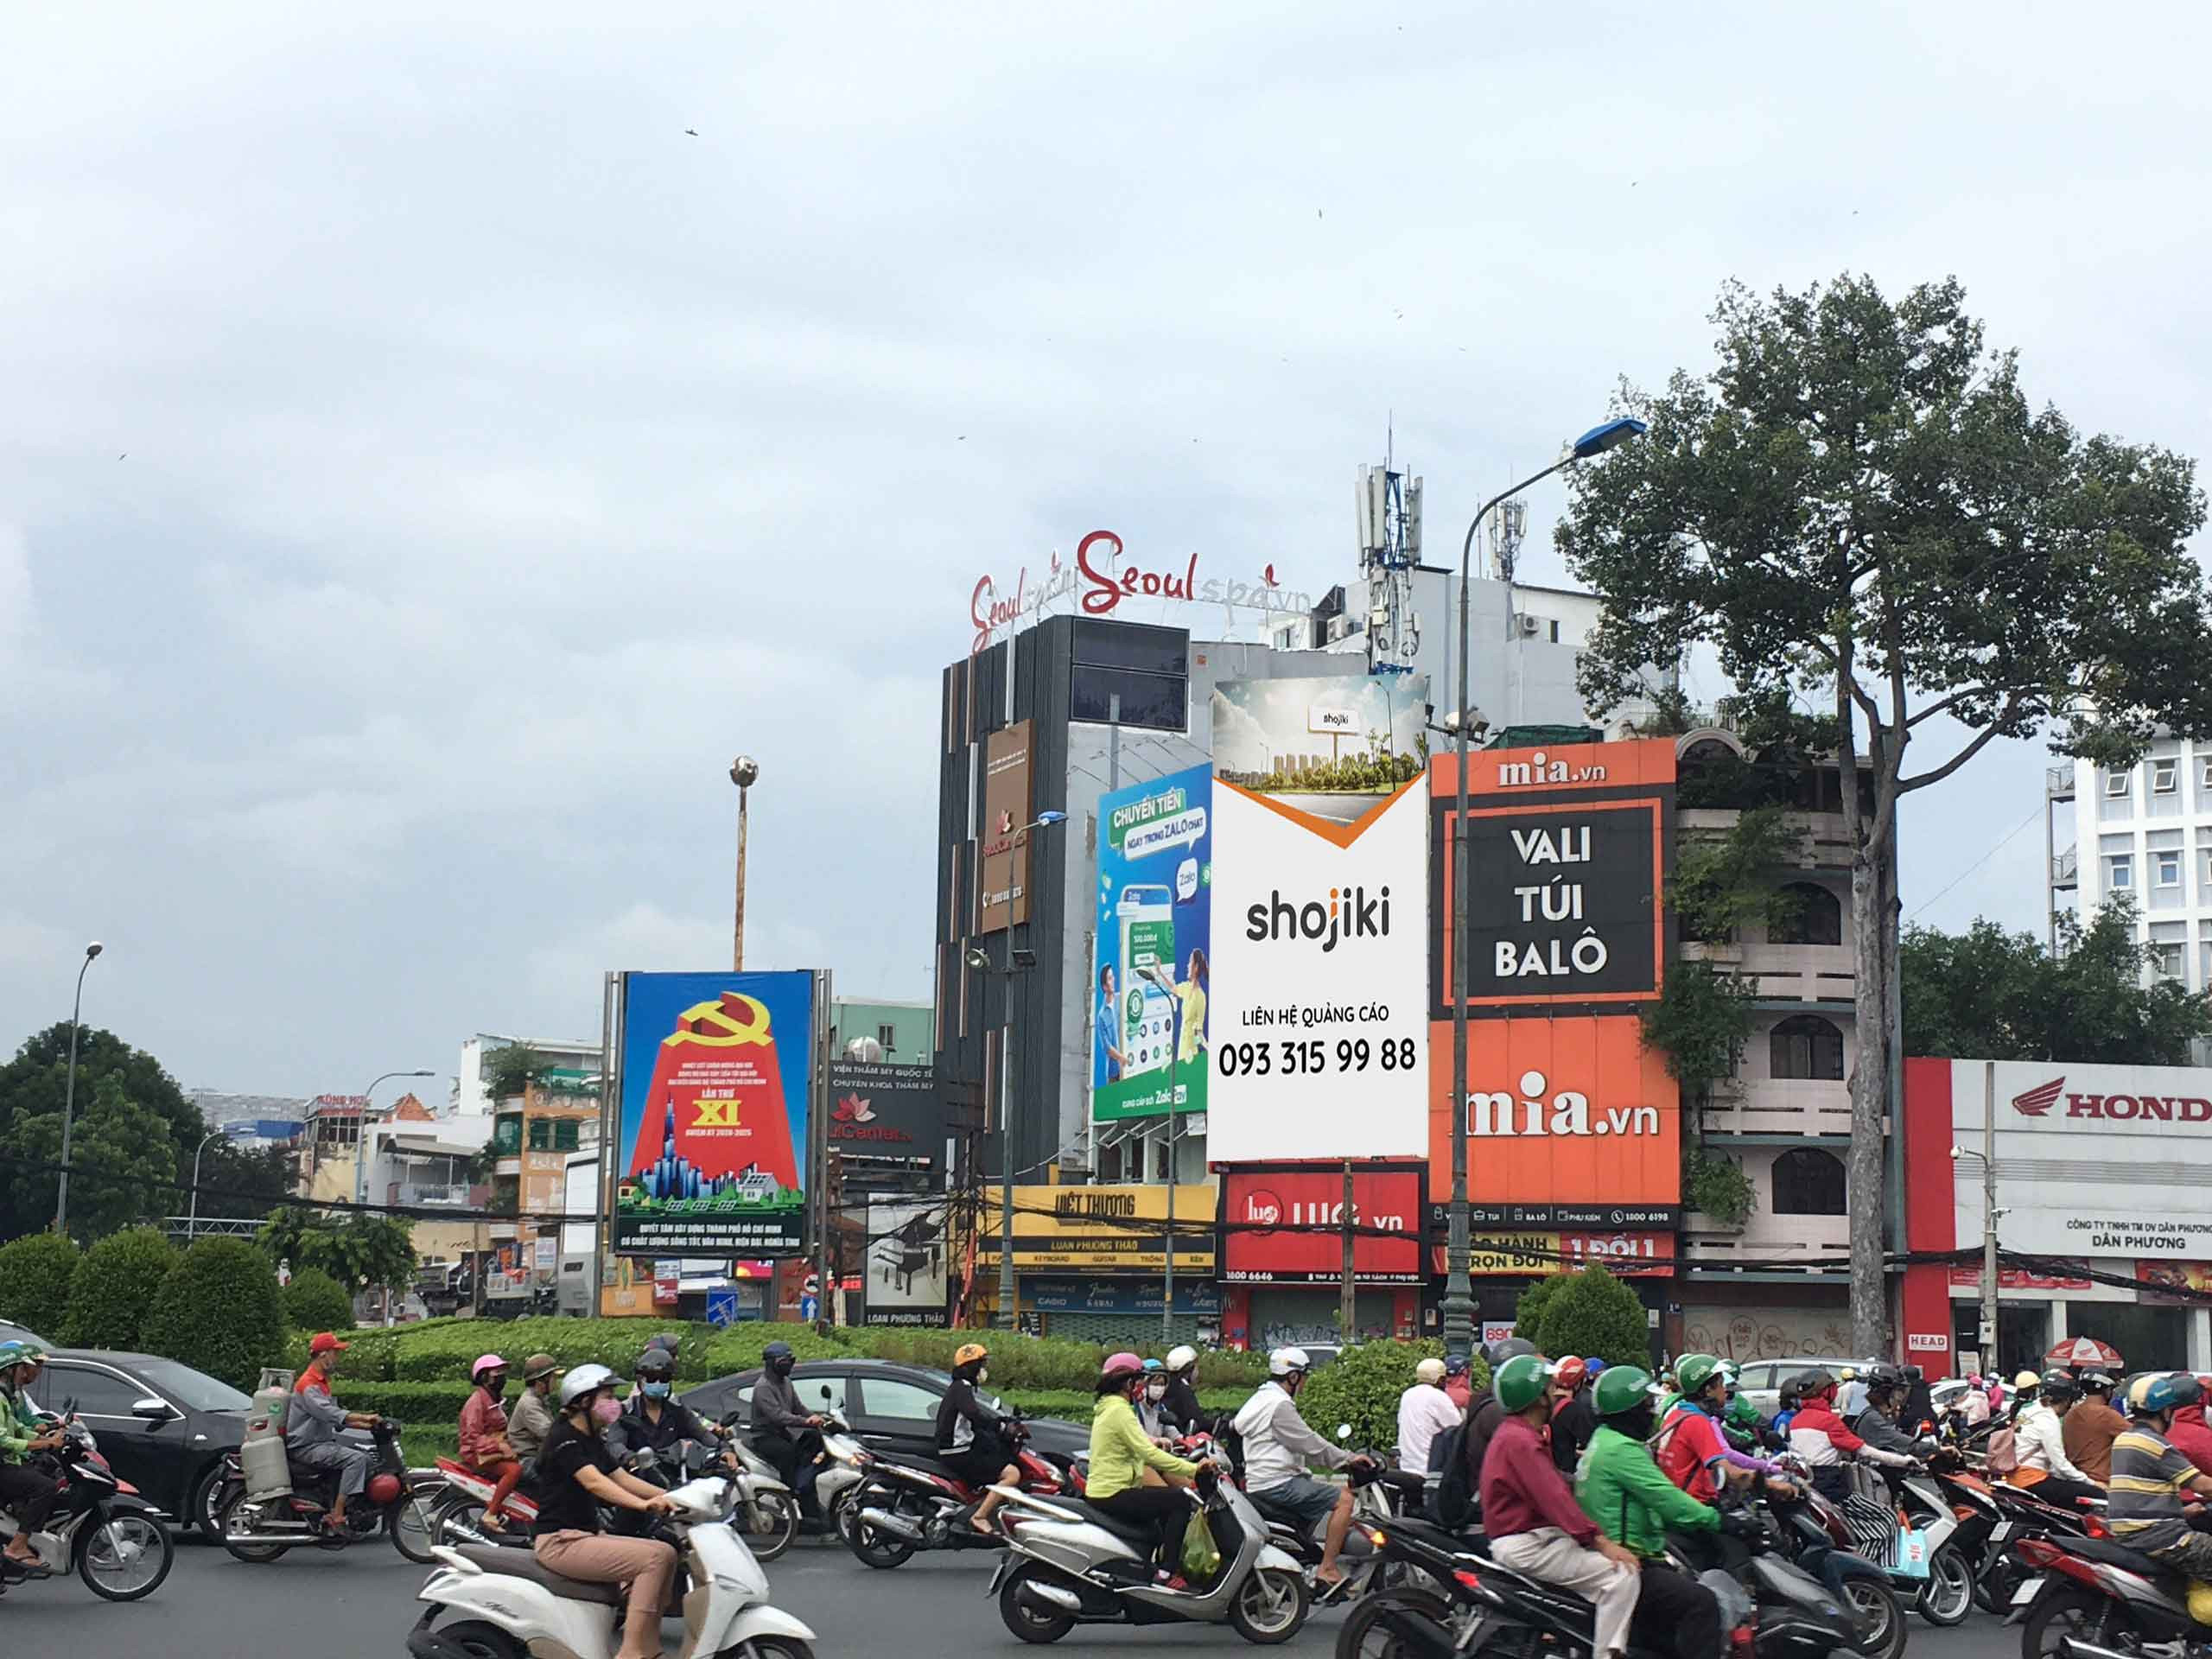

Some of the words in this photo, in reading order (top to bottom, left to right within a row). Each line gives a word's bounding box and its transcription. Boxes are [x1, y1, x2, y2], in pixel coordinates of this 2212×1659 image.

[1498, 752, 1605, 786] mia.vn
[1113, 794, 1155, 828] CHUYỂN
[1156, 785, 1182, 815] TIỀN
[1165, 818, 1187, 839] ZALO
[1510, 826, 1591, 865] VALI
[1514, 875, 1583, 922] TÚI
[1245, 886, 1390, 952] shojiki
[1495, 926, 1608, 977] BALÔ
[1242, 1006, 1274, 1027] LIÊN
[1278, 1004, 1298, 1027] HỆ
[1301, 1002, 1355, 1027] QUẢNG
[1358, 1004, 1389, 1023] CÁO
[1218, 1042, 1271, 1077] 093
[1281, 1040, 1325, 1074] 315
[1336, 1039, 1370, 1072] 99
[1381, 1037, 1416, 1071] 88
[692, 1099, 742, 1126] XI
[1447, 1071, 1659, 1136] mia.vn
[2066, 1093, 2212, 1122] HOND
[1248, 1195, 1279, 1225] lug
[2066, 1218, 2092, 1230] CÔNG
[2094, 1220, 2105, 1230] TY
[2107, 1221, 2130, 1231] TNHH
[2158, 1221, 2176, 1233] DÂN
[2092, 1232, 2121, 1247] DÂN
[2125, 1236, 2186, 1249] PHƯƠNG
[1571, 1238, 1582, 1259] 1
[1643, 1238, 1655, 1258] 1
[1910, 1336, 1946, 1347] HEAD
